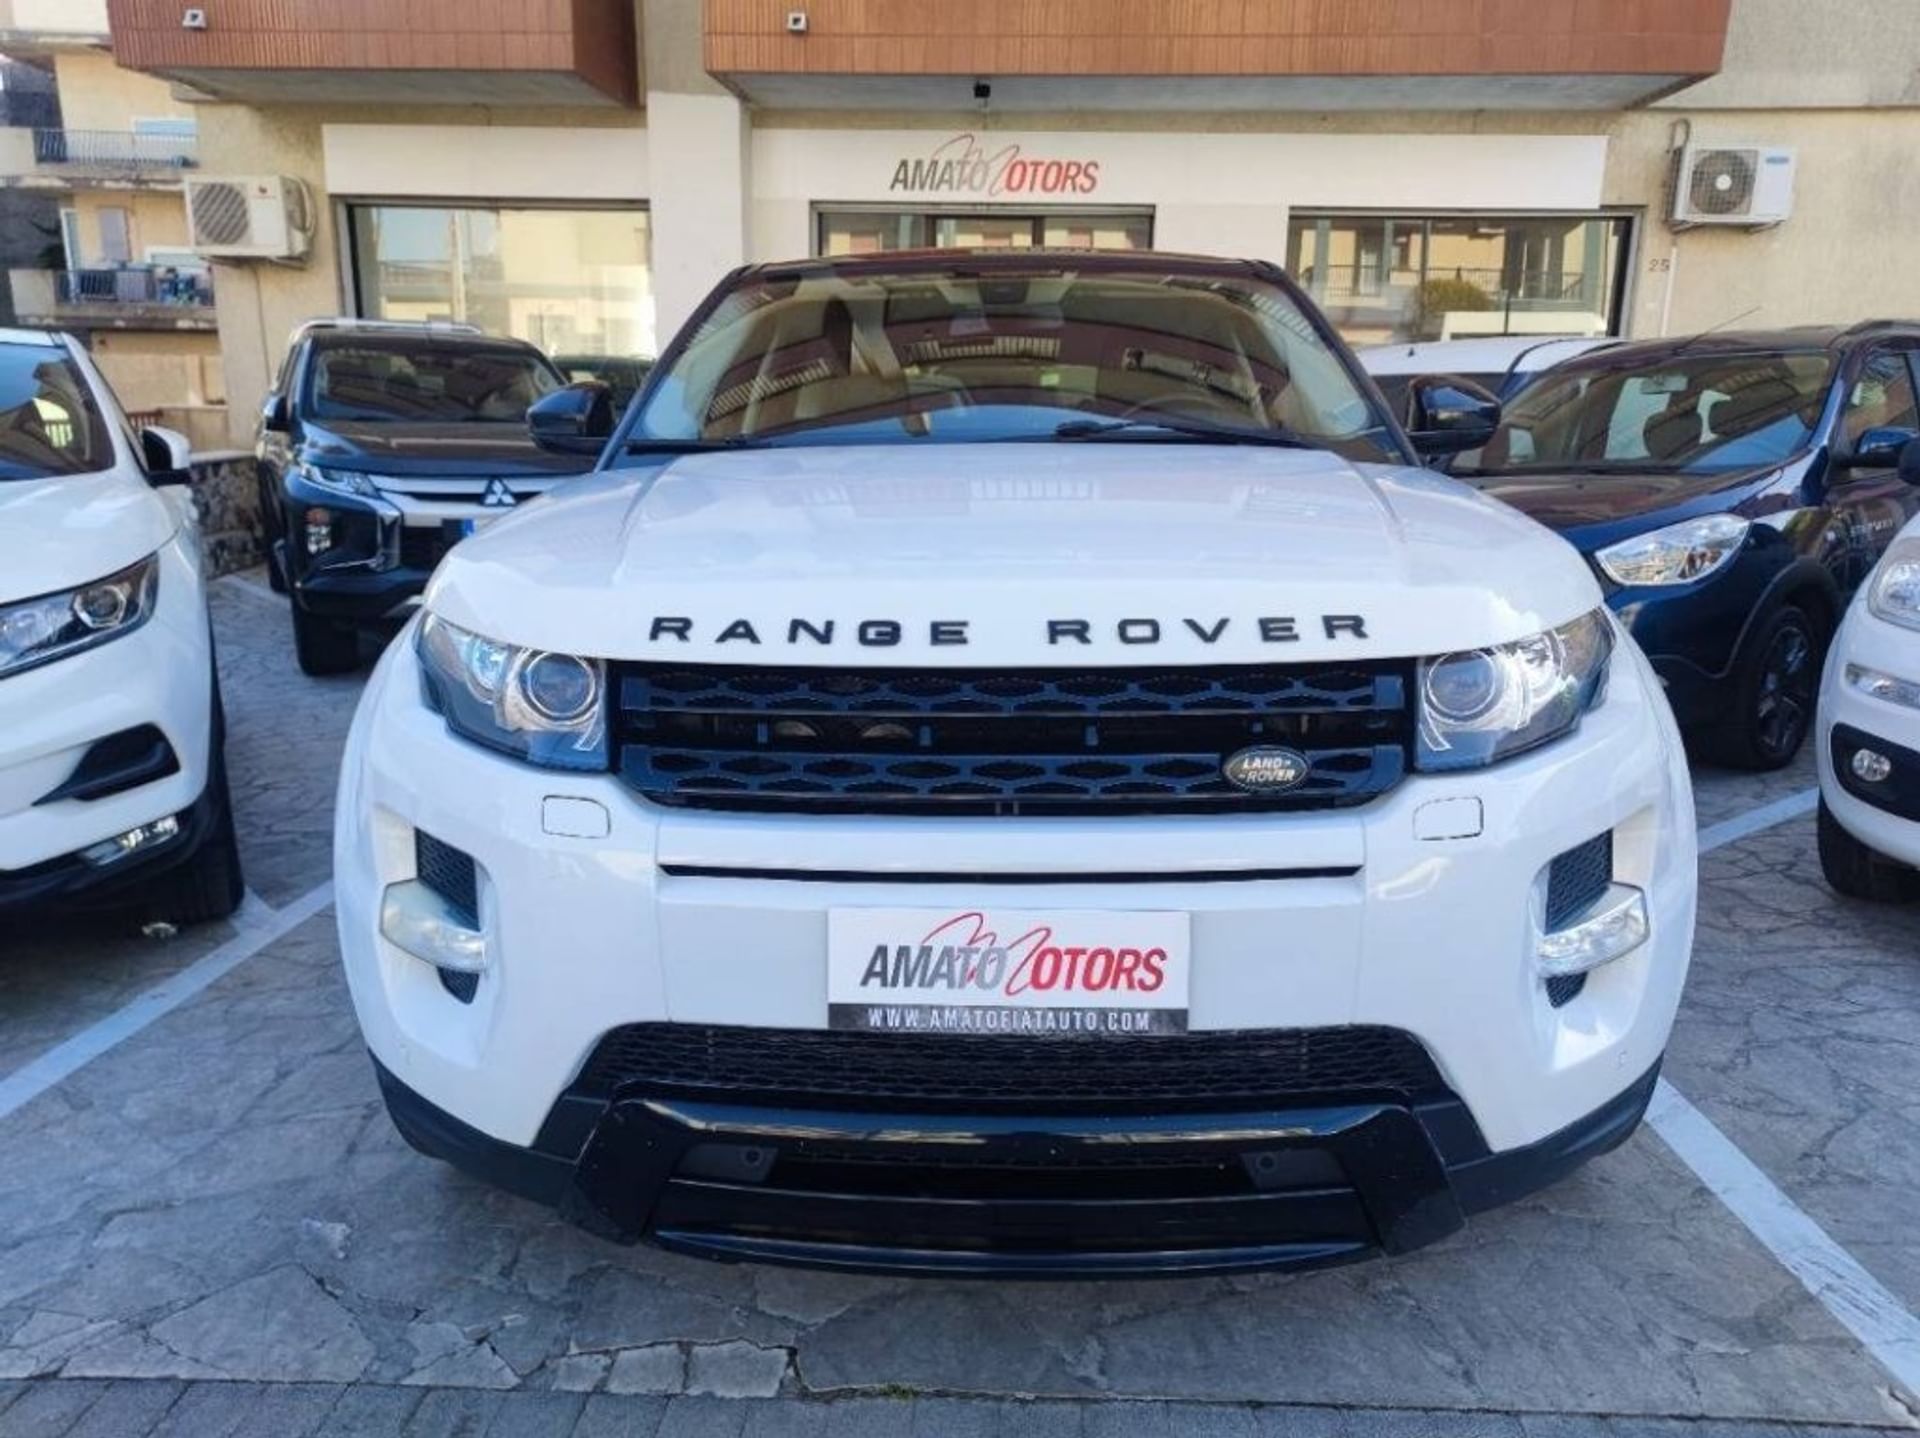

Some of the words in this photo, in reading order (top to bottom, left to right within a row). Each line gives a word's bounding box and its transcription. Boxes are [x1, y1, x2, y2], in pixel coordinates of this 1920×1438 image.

[890, 159, 989, 193] AMATO
[649, 616, 970, 647] RANGE
[1046, 614, 1369, 645] ROVER
[860, 944, 1007, 989] AMATO
